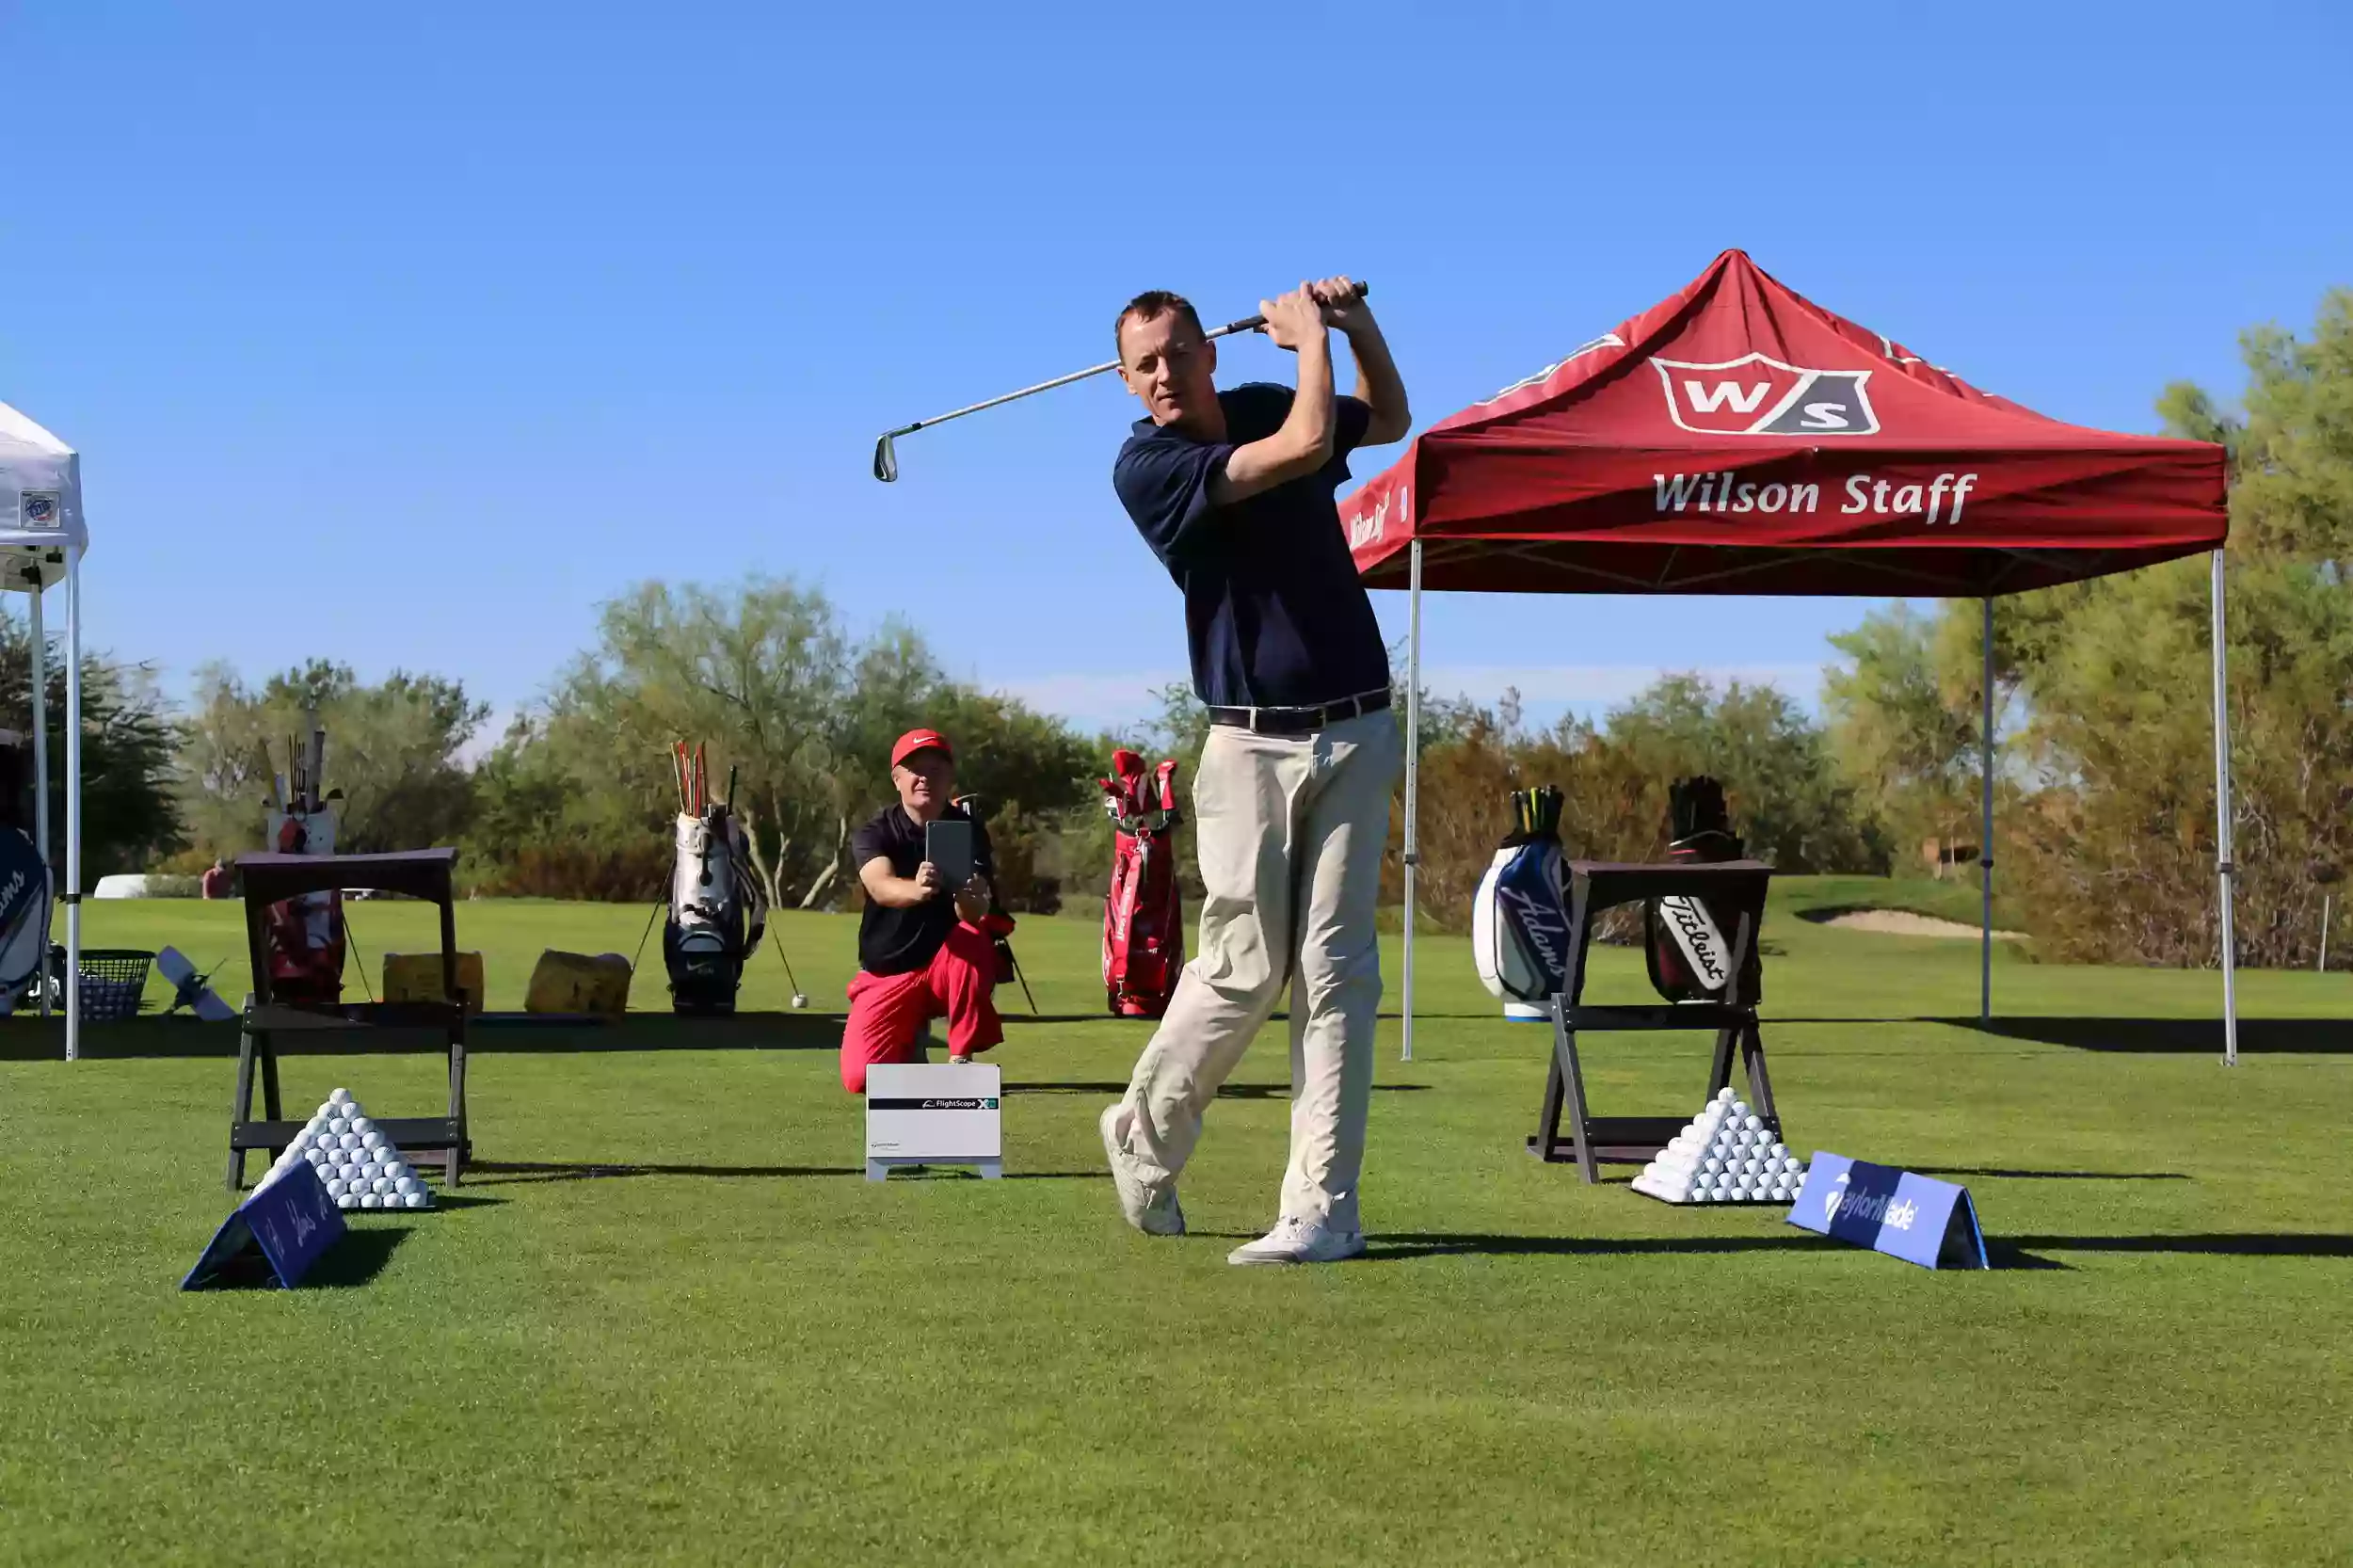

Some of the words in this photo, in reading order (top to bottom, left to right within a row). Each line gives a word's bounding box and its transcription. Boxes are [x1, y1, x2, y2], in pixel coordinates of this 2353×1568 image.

[1683, 380, 1771, 412] W
[1654, 472, 1819, 513] Wilson
[1841, 473, 1977, 524] Staff
[1501, 887, 1566, 978] Adams
[1662, 895, 1724, 980] Titleist
[936, 1099, 976, 1109] FlightScope
